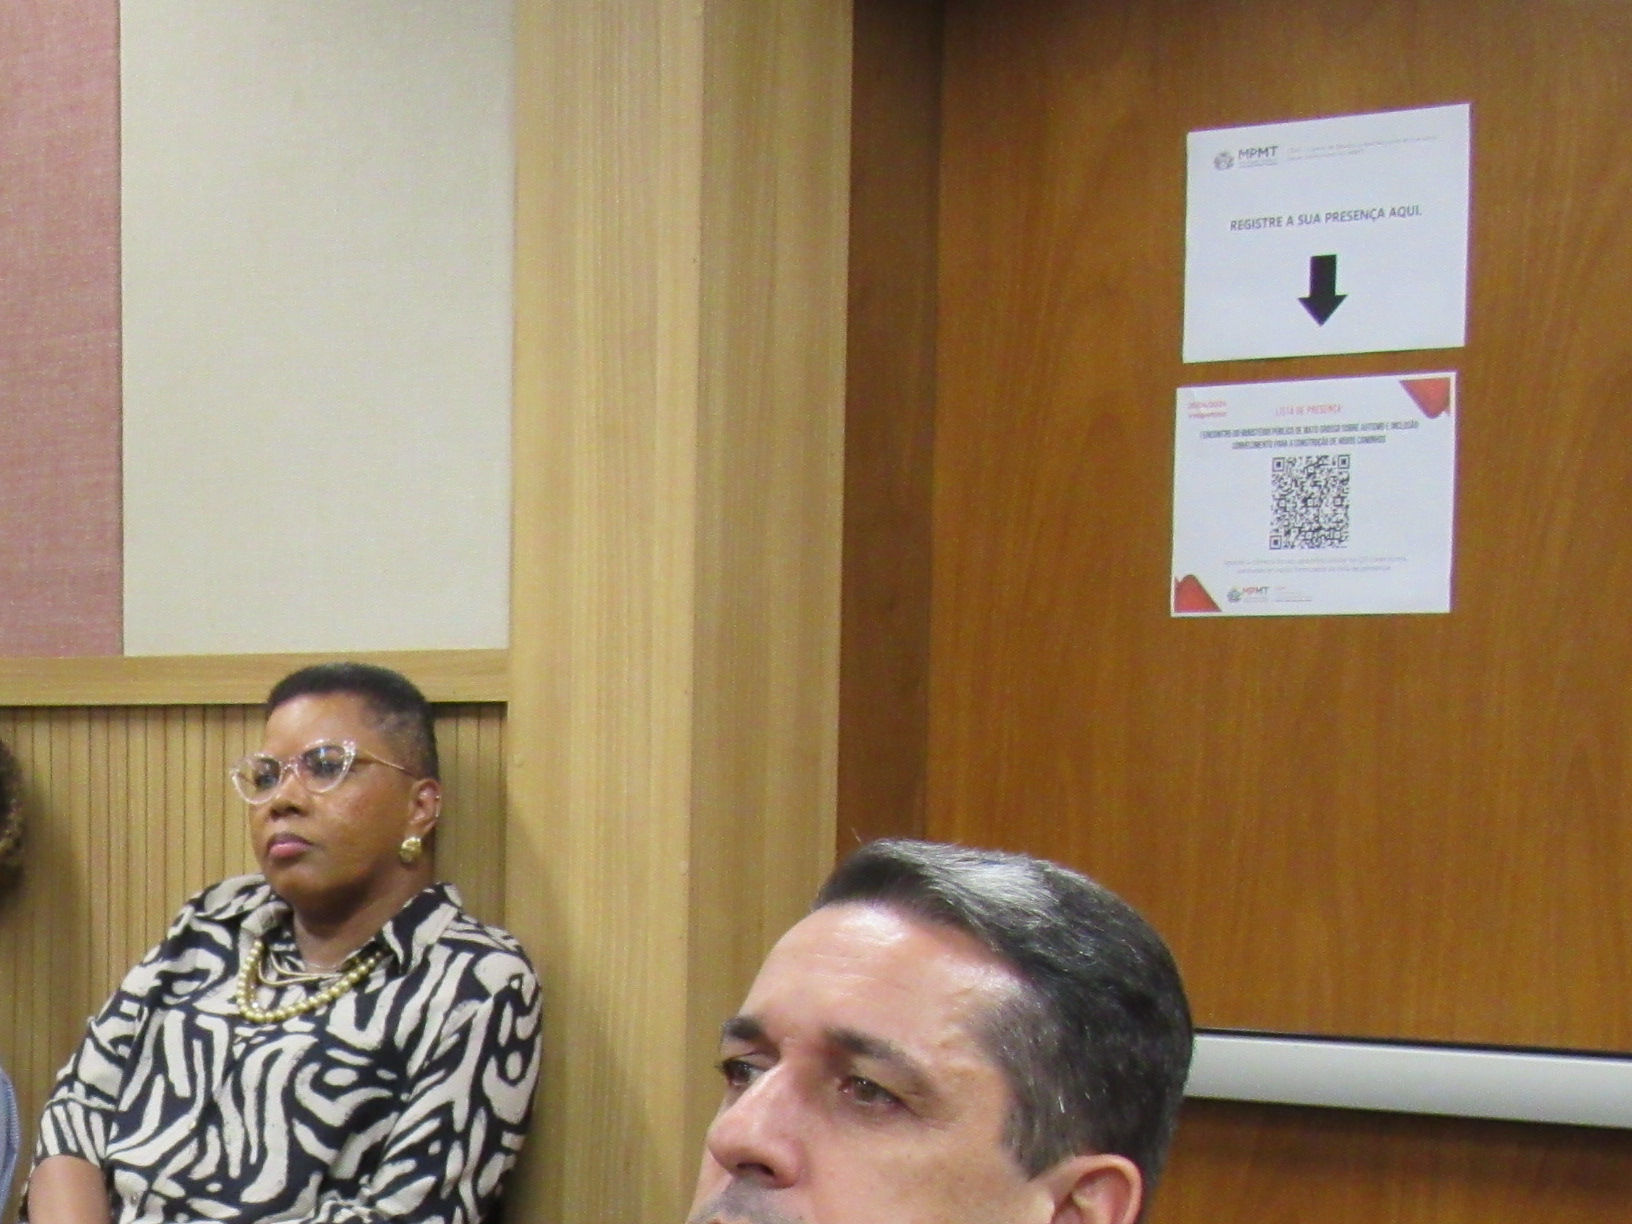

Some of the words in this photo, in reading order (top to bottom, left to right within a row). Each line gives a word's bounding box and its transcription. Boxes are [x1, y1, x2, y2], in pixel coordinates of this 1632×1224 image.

[1238, 145, 1279, 160] MPMT
[1230, 215, 1283, 231] REGISTRE
[1285, 214, 1294, 227] A
[1297, 213, 1321, 226] SUA
[1325, 208, 1385, 223] PRESENÇA
[1388, 204, 1423, 218] AQUI.
